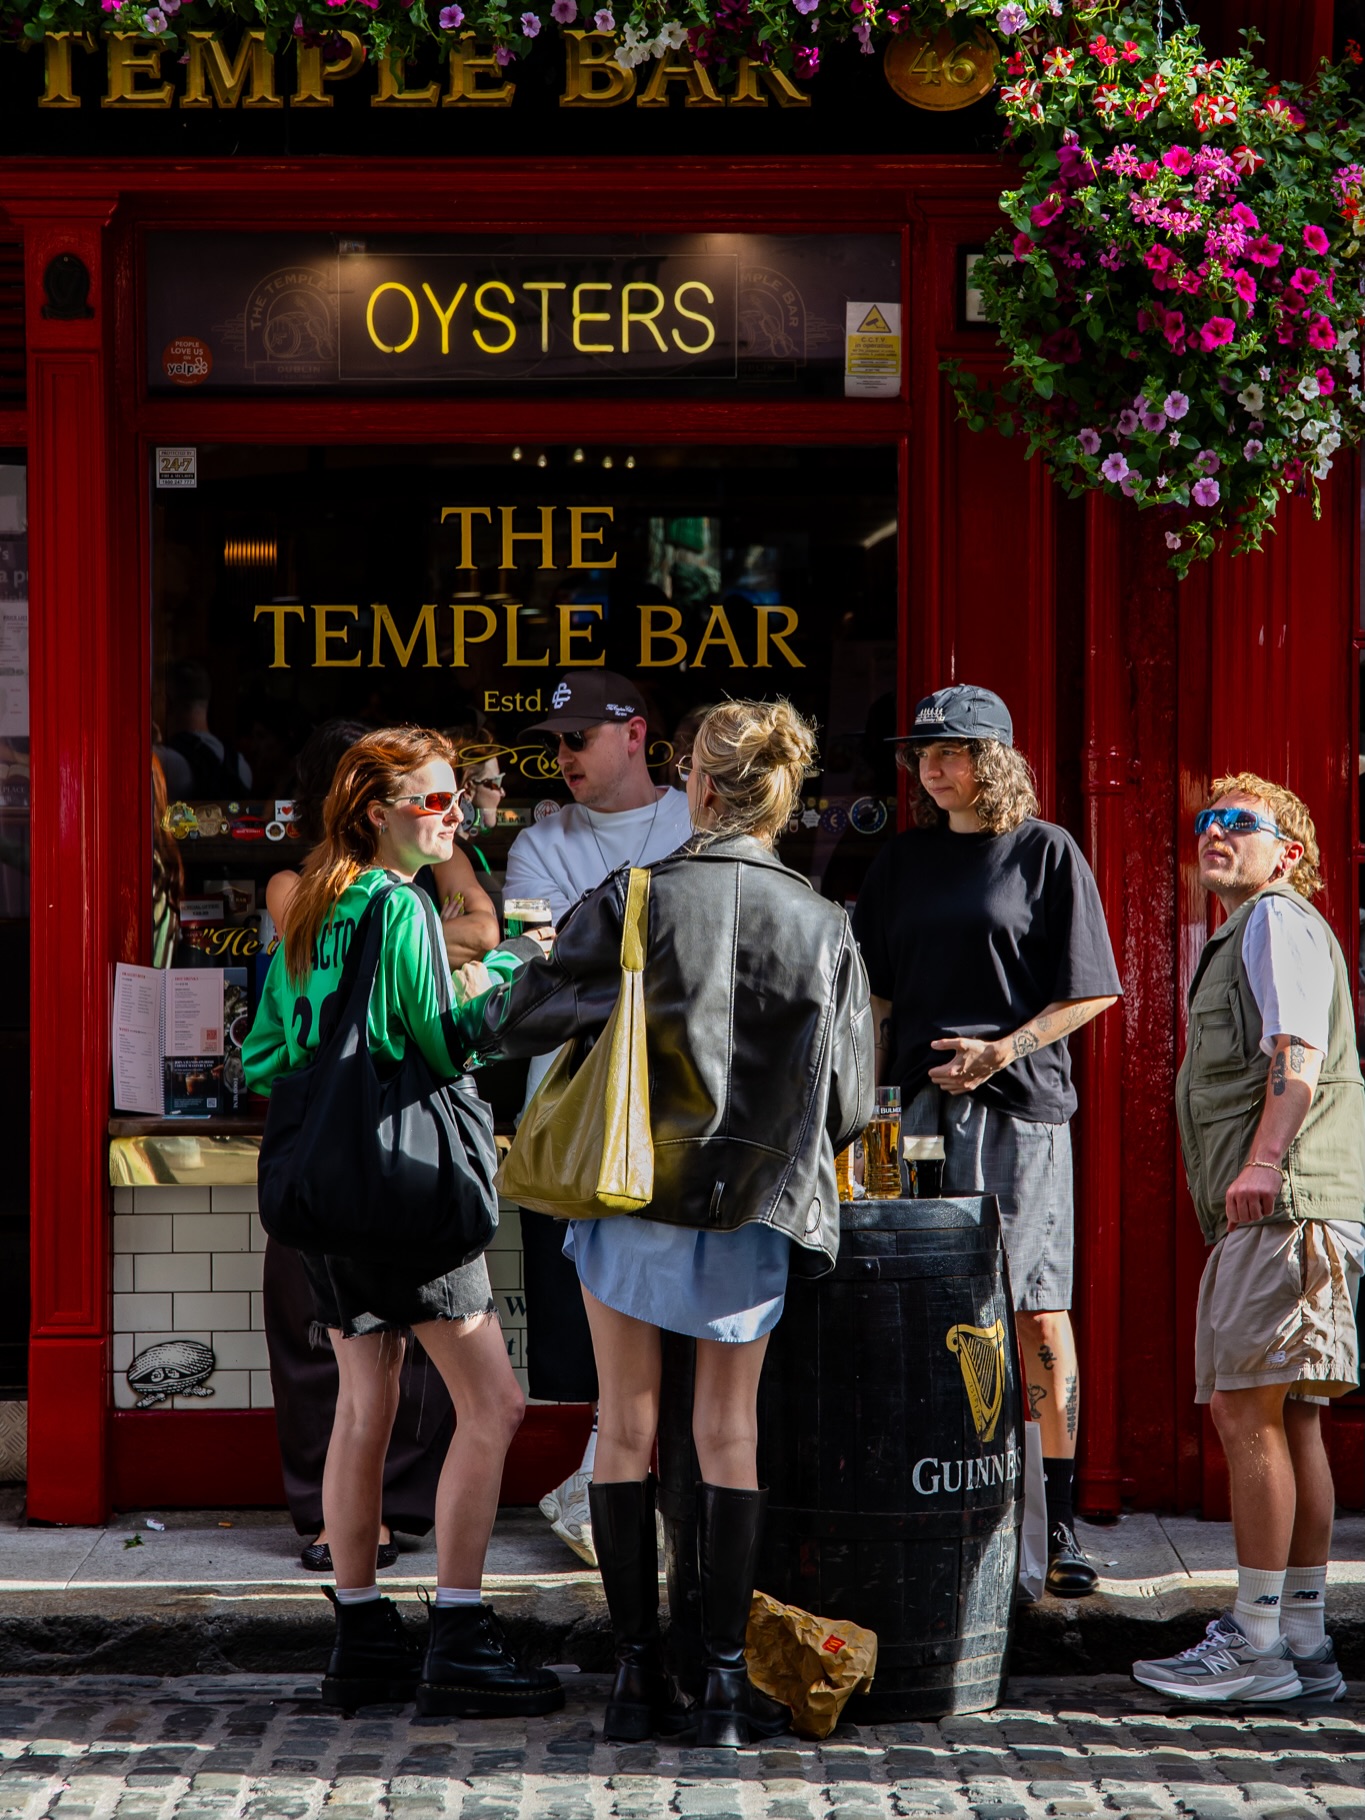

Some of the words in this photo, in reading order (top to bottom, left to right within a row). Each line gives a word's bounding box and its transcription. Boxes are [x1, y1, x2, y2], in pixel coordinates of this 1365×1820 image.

[17, 29, 516, 108] TEMPLE
[906, 40, 980, 86] 46
[366, 280, 716, 354] OYSTERS
[167, 361, 196, 377] yelp
[171, 347, 192, 355] LOVE
[193, 348, 204, 356] US
[440, 505, 618, 571] THE
[253, 603, 606, 669] TEMPLE
[636, 604, 806, 669] BAR
[483, 690, 549, 713] Estd.
